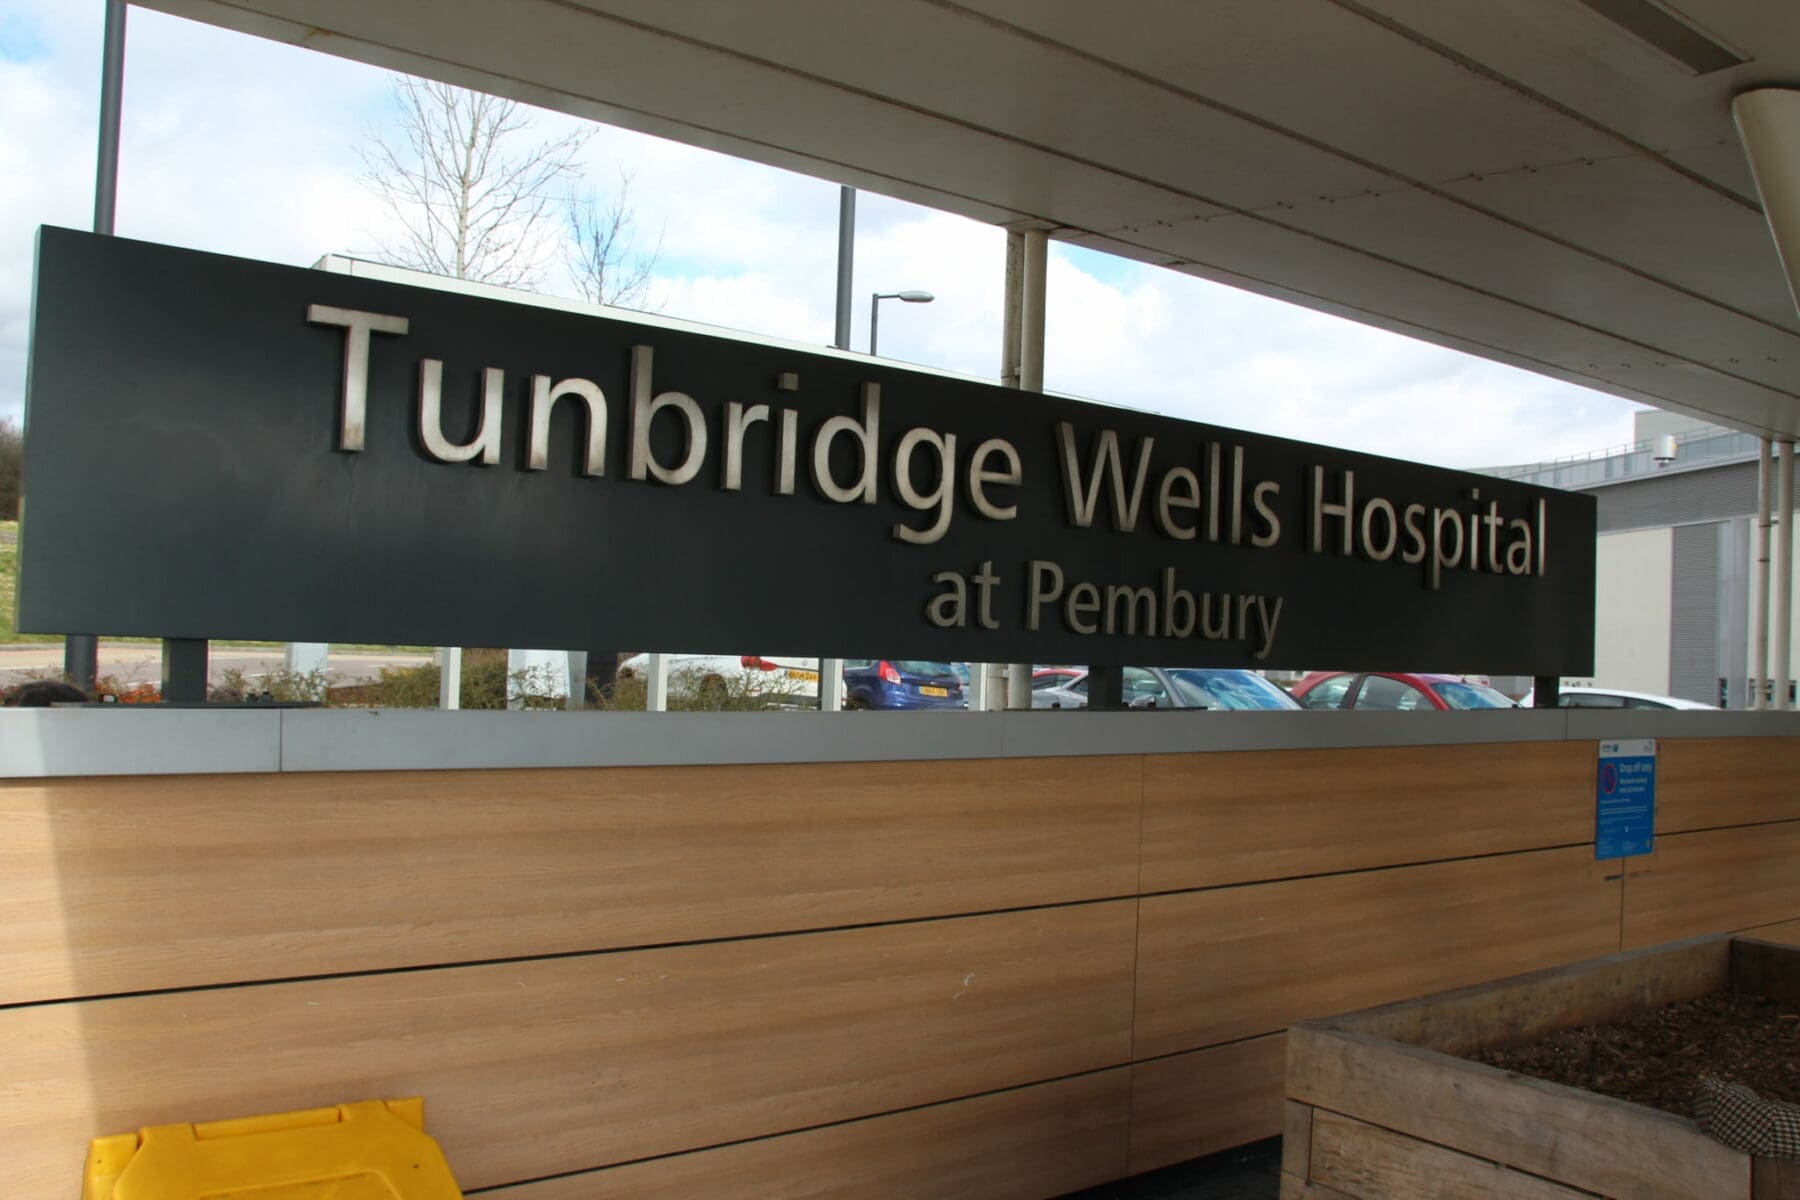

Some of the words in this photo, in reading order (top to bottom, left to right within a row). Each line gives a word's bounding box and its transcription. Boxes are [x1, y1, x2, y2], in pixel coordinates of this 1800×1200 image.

[305, 303, 1023, 545] Tunbridge
[1055, 421, 1281, 548] Wells
[1309, 463, 1547, 590] Hospital
[926, 560, 1000, 631] at
[1026, 559, 1284, 661] Pembury
